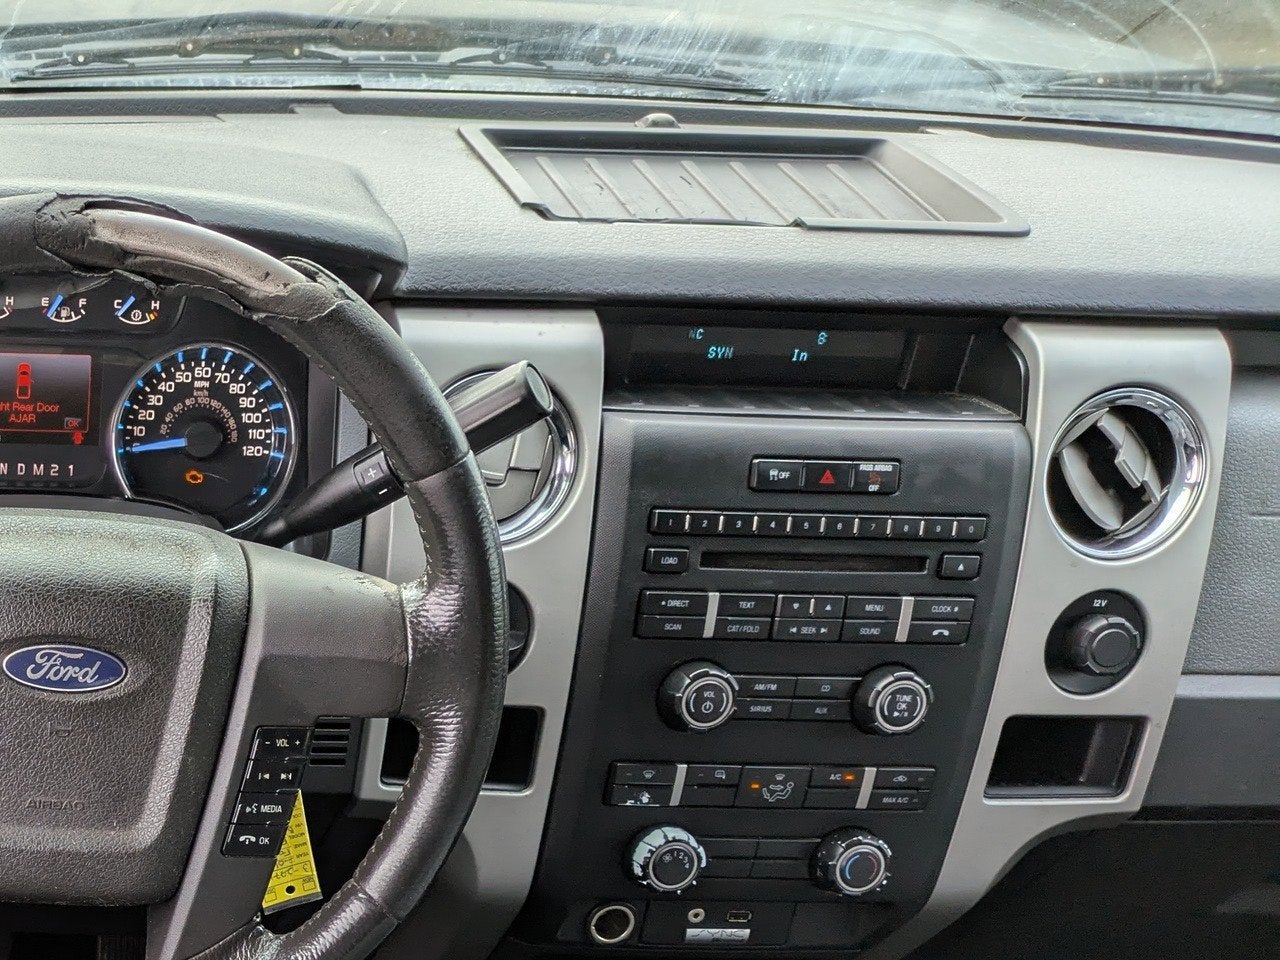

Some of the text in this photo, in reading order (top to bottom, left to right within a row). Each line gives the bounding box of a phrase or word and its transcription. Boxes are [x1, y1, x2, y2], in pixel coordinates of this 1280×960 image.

[6, 297, 13, 306] H
[42, 297, 49, 307] E
[78, 298, 87, 308] F
[114, 300, 122, 309] C
[151, 301, 159, 310] H
[175, 372, 192, 383] 50
[194, 367, 212, 378] 60
[215, 373, 230, 384] 70
[158, 382, 175, 392] 40
[229, 383, 246, 394] 80
[147, 395, 163, 406] 30
[239, 397, 256, 408] 90
[12, 402, 34, 412] Rear
[37, 402, 60, 412] Door
[8, 414, 36, 423] AJAR
[138, 410, 155, 421] 20
[241, 413, 262, 423] 100
[133, 426, 146, 437] 10
[248, 429, 265, 440] 110
[242, 446, 263, 457] 120
[0, 463, 8, 475] N
[17, 463, 26, 475] D
[33, 464, 44, 476] M
[50, 464, 59, 476] 2
[69, 464, 74, 477] 1
[779, 471, 791, 479] OFF
[865, 604, 884, 612] MENU
[26, 650, 99, 684] Ford
[754, 683, 777, 691] AM/FM
[749, 705, 772, 713] SIRIUS
[276, 739, 289, 747] VOL
[261, 804, 282, 813] MEDIA
[259, 837, 270, 845] OK
